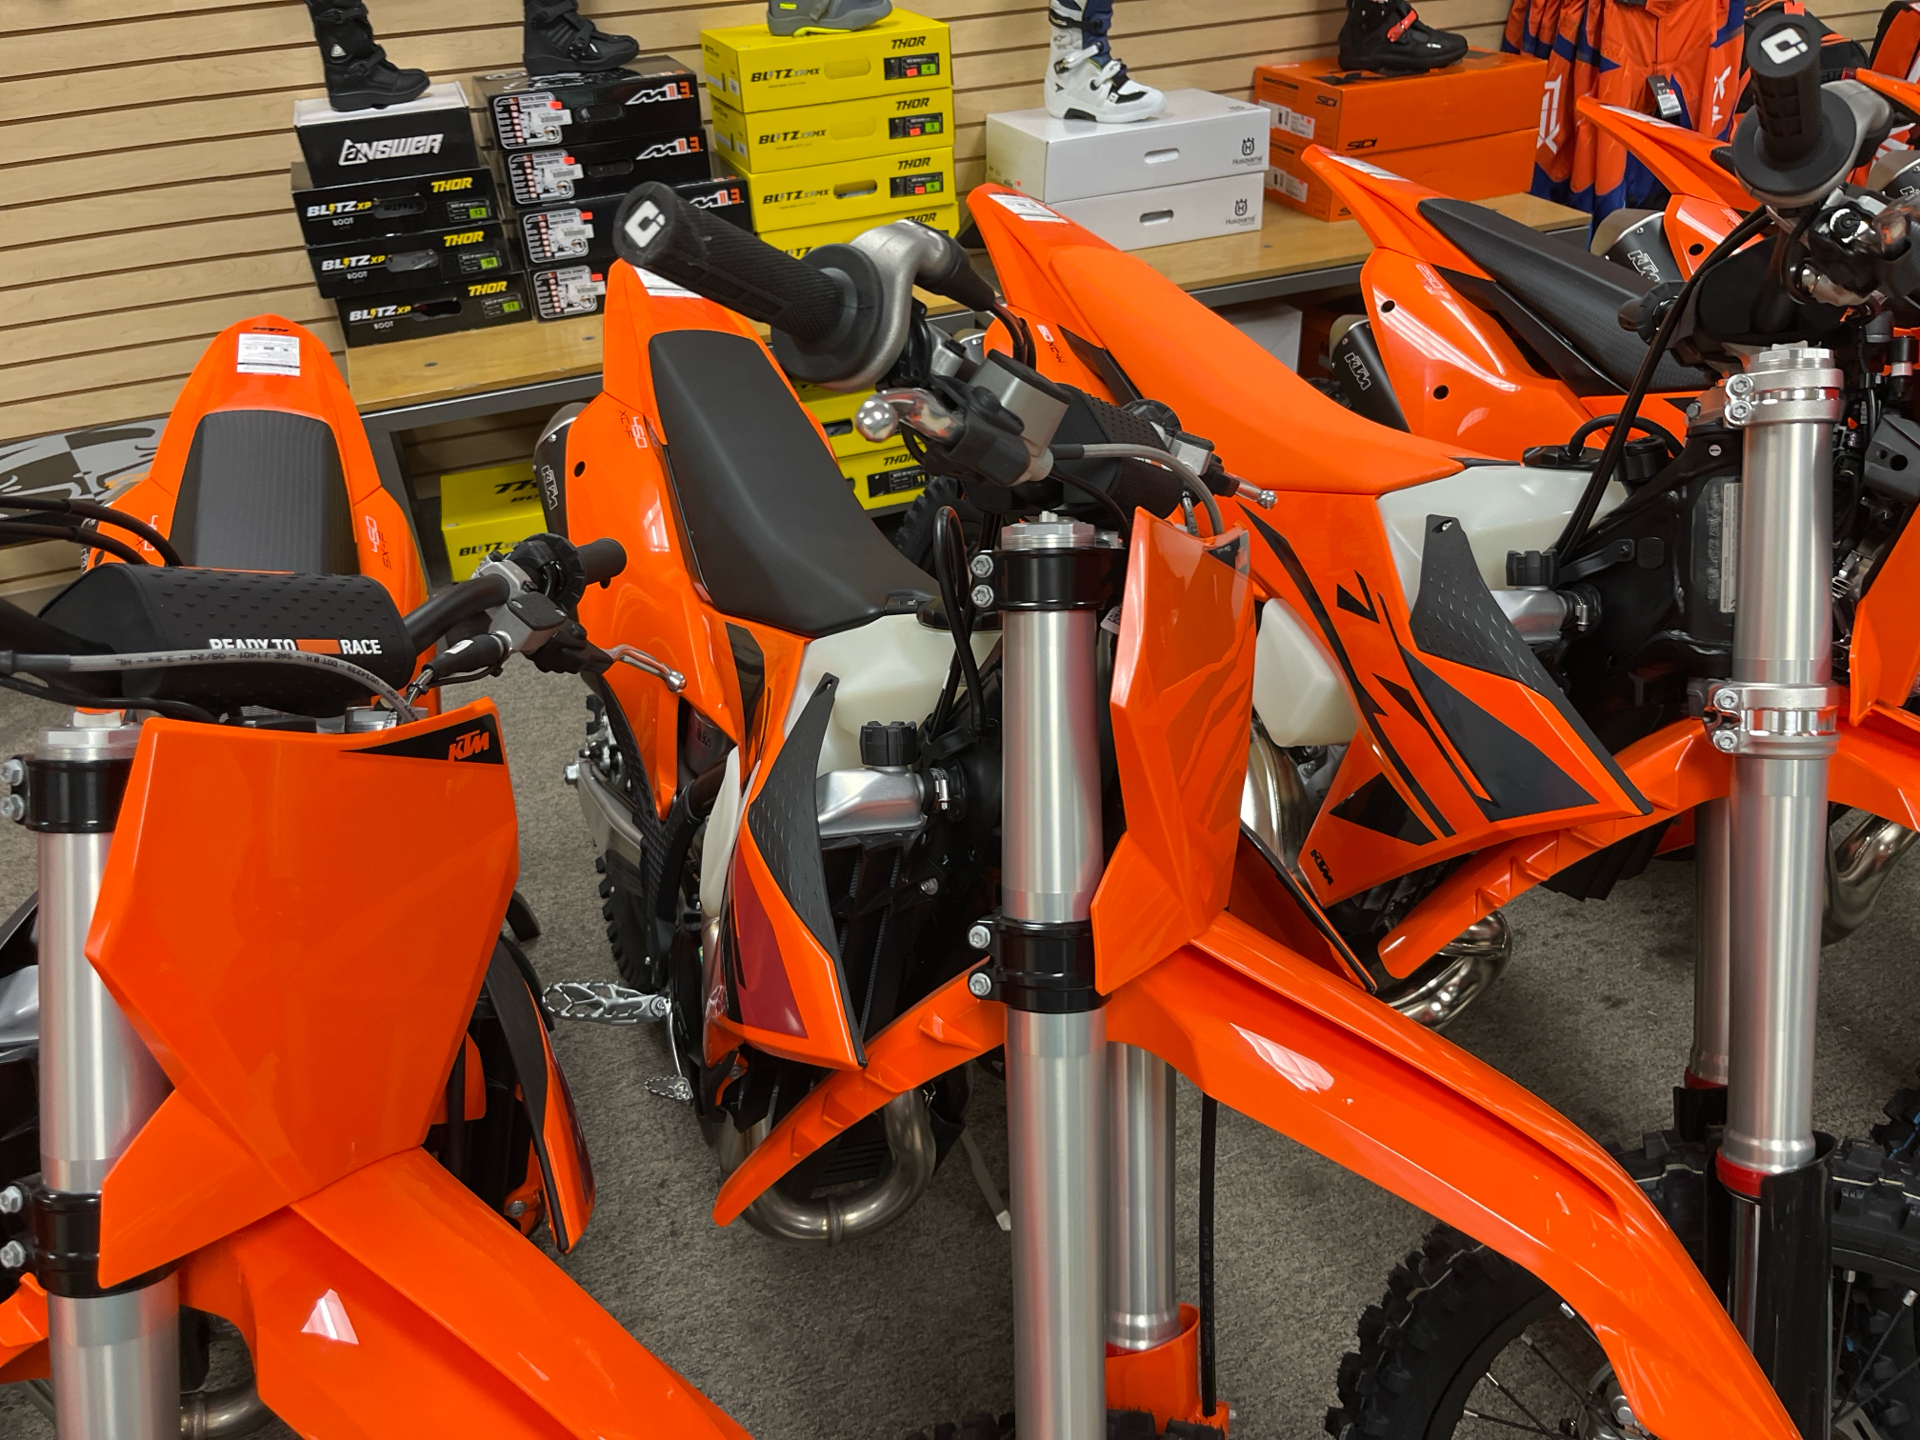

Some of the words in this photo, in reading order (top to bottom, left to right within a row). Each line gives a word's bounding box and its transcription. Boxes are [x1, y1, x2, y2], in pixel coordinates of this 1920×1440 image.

[891, 36, 926, 50] THOR
[895, 97, 930, 111] THOR
[897, 157, 931, 171] THOR
[1232, 155, 1262, 165] Husqvarna
[430, 177, 473, 193] THOR
[307, 200, 357, 218] BLITZ
[356, 201, 373, 211] XP
[1225, 216, 1255, 226] Husqvarna
[443, 230, 485, 247] THOR
[321, 254, 371, 271] BLITZ
[370, 254, 386, 264] XP
[467, 281, 508, 297] THOR
[349, 304, 397, 322] BLITZ
[397, 305, 412, 315] XP
[1344, 352, 1372, 391] KTM
[631, 416, 648, 449] 450
[541, 465, 559, 511] KTM
[365, 515, 380, 553] 450
[271, 639, 297, 650] TO
[340, 639, 382, 654] RACE
[189, 653, 226, 661] 05/24
[274, 651, 293, 659] SAE
[448, 730, 489, 762] KTM
[1310, 849, 1334, 886] KTM
